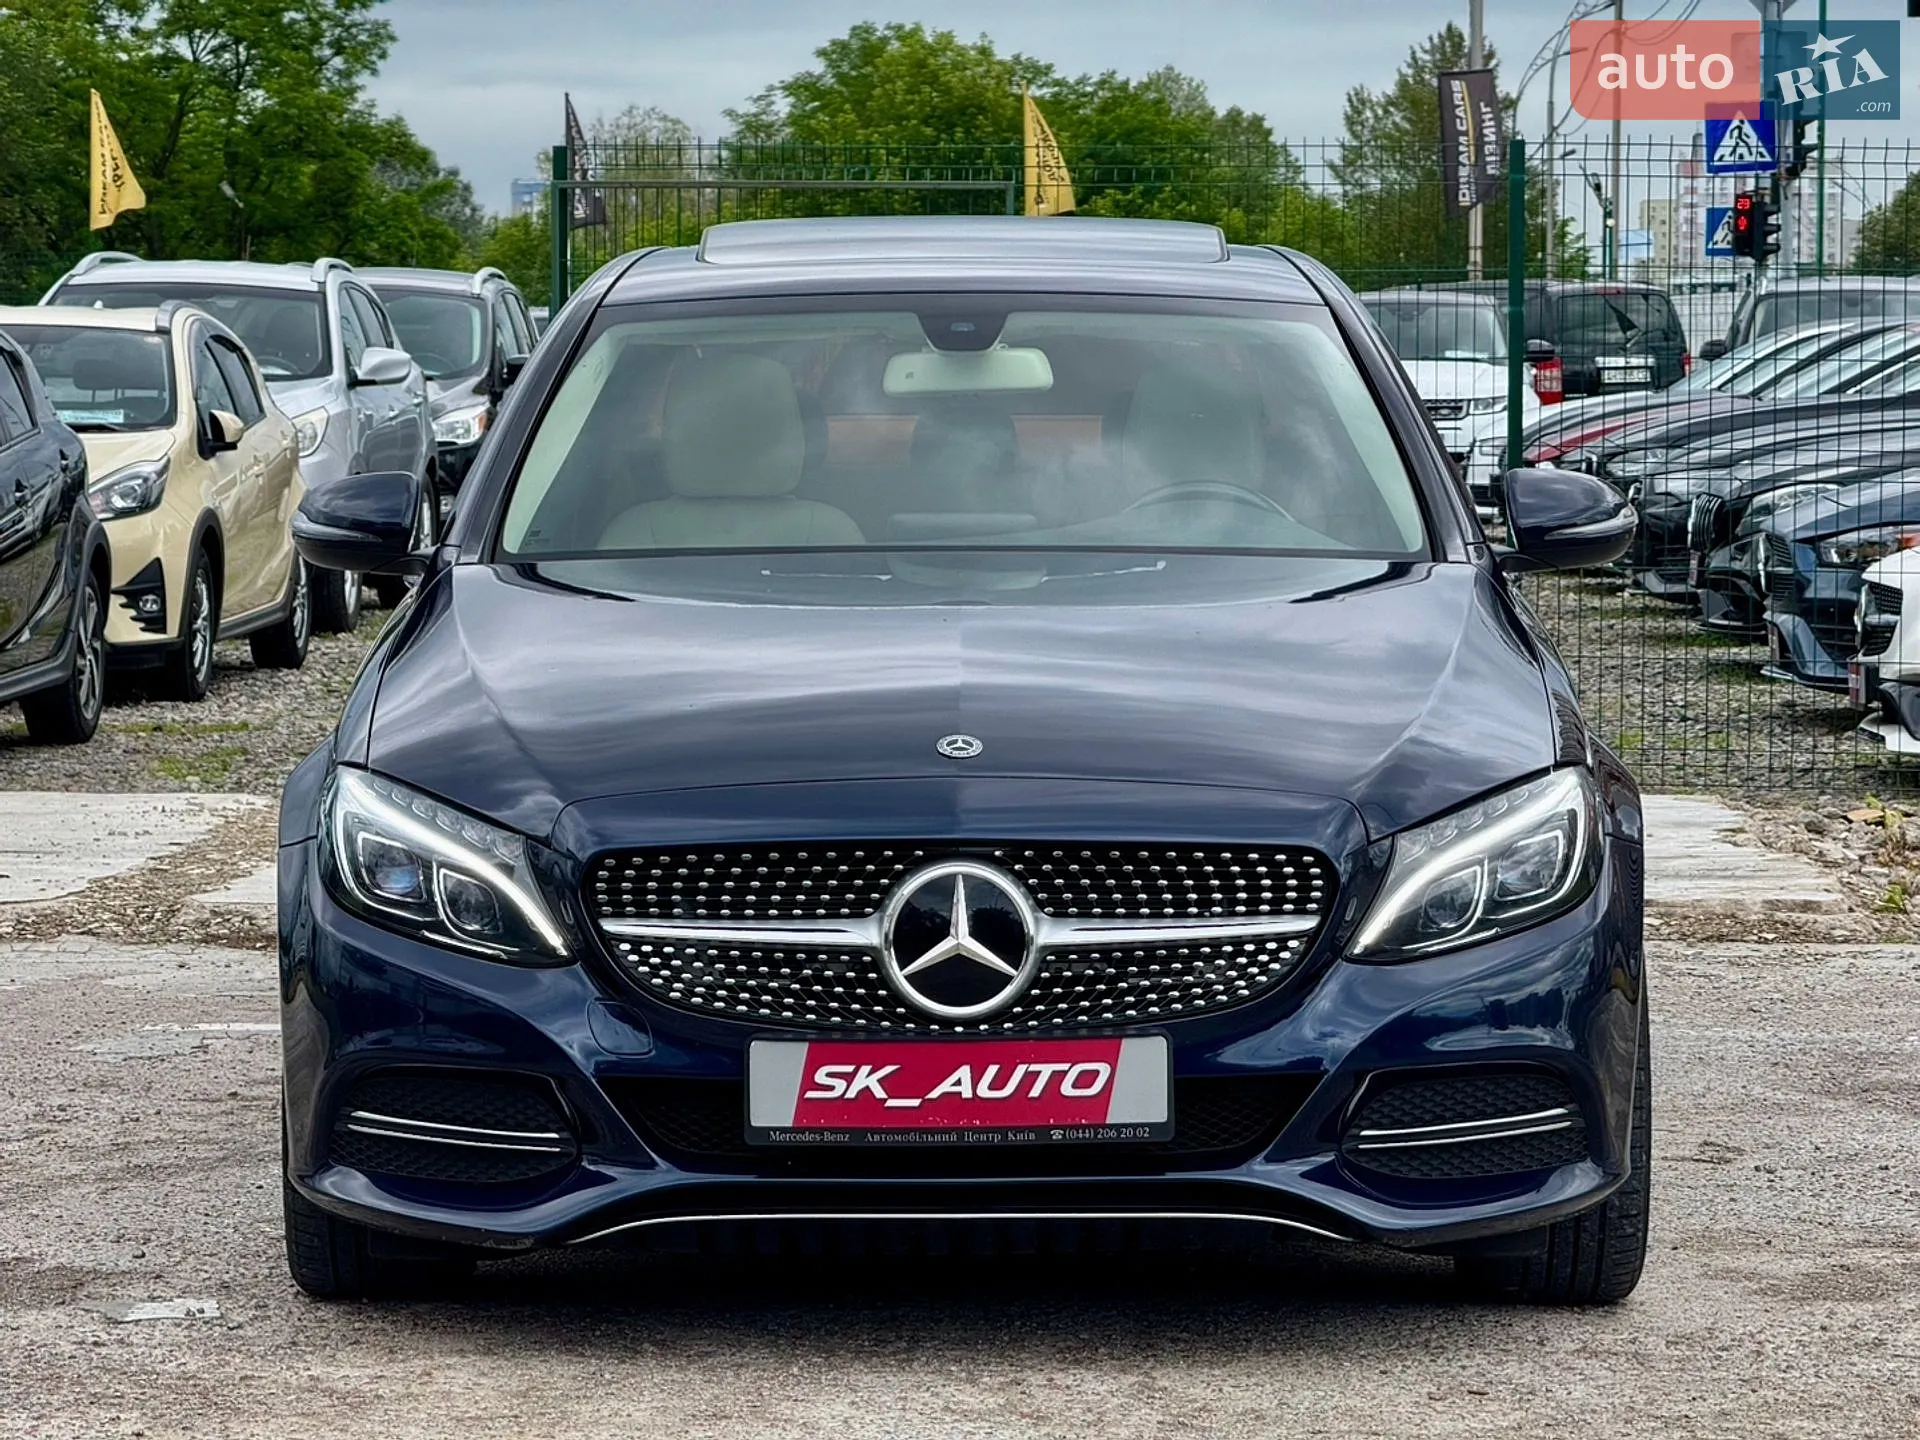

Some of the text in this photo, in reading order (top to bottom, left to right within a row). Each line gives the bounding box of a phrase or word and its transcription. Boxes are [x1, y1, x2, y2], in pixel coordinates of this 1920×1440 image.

[1450, 79, 1471, 202] DREAM CARS
[804, 1062, 1111, 1107] SK_AUTO
[769, 1131, 850, 1142] Mercedes-Benz
[865, 1130, 1036, 1143] Автомобільний Центр Київ
[1066, 1127, 1150, 1139] (044) 206 20 02
